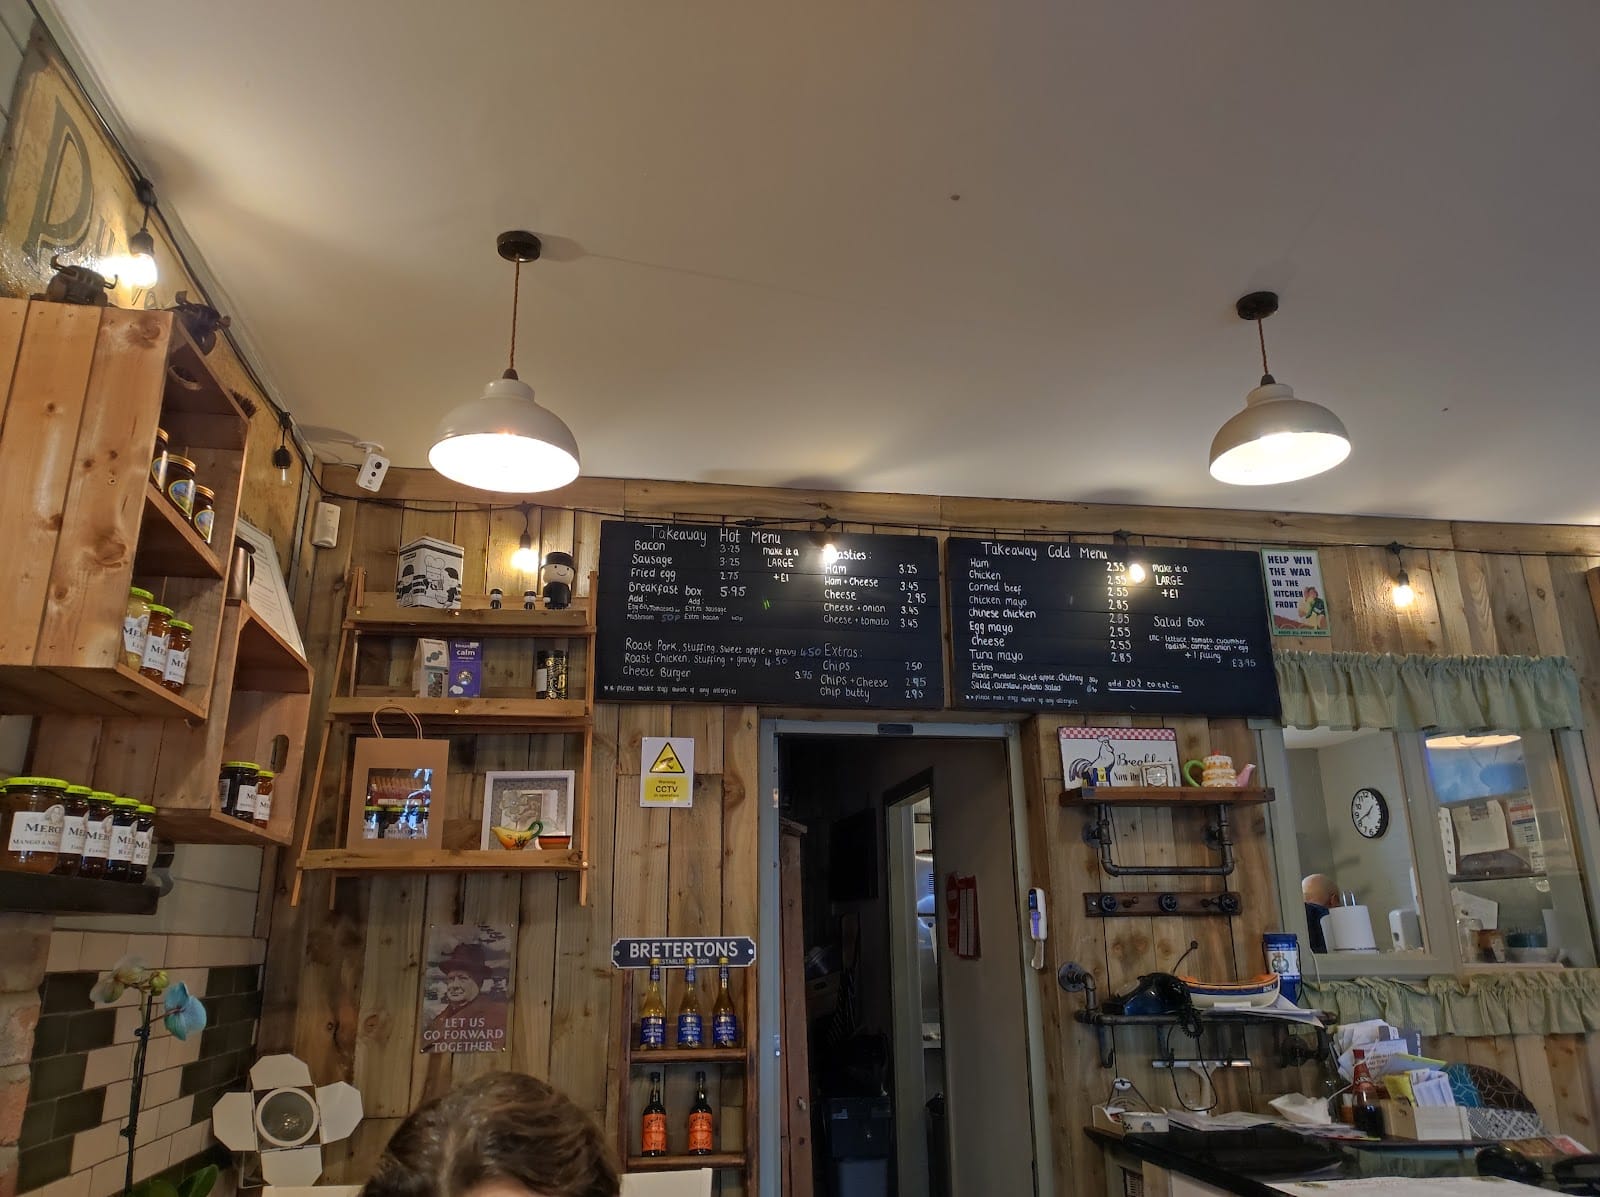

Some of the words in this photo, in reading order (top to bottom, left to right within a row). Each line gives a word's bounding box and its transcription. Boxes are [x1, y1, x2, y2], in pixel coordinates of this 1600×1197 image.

[644, 525, 707, 547] Takeaway
[720, 528, 741, 543] Hot
[751, 531, 781, 544] Menu
[634, 540, 665, 551] Bacon
[981, 541, 1037, 561] Takeaway
[1048, 544, 1071, 559] Cold
[1080, 547, 1108, 560] Menu
[632, 554, 672, 567] Sausage
[767, 558, 794, 568] LARGE
[970, 558, 989, 568] Ham
[1107, 562, 1126, 572] 2.55
[1267, 555, 1289, 564] HELP
[1294, 556, 1313, 565] WIN
[631, 568, 655, 578] Fried
[660, 570, 676, 582] egg
[720, 571, 739, 580] 2.75
[825, 564, 847, 575] Ham
[899, 564, 918, 574] 3.25
[1152, 564, 1172, 573] make
[1269, 567, 1286, 576] THE
[1290, 568, 1312, 577] WAR
[824, 577, 842, 586] Ham
[849, 578, 879, 587] Cheese
[900, 582, 919, 591] 3.45
[969, 570, 1001, 580] Chicken
[1107, 575, 1127, 585] 2.55
[1156, 575, 1184, 586] LARGE
[1272, 579, 1282, 587] ON
[629, 582, 678, 595] Breakfast
[685, 585, 702, 596] box
[720, 586, 747, 597] 5.95
[969, 582, 1000, 592] Corned
[1004, 582, 1022, 595] beef
[1107, 587, 1129, 597] 2.55
[1274, 590, 1304, 598] KITCHEN
[824, 590, 857, 600] Cheese
[907, 593, 927, 604] 2.95
[969, 595, 1000, 605] Chicken
[1005, 598, 1027, 610] mayo
[1108, 599, 1129, 610] 2.85
[824, 603, 854, 612] Cheese
[863, 604, 886, 612] onion
[901, 607, 919, 615] 3.45
[1275, 601, 1299, 609] FRONT
[968, 609, 999, 618] Chinese
[823, 615, 852, 624] Cheese
[861, 616, 890, 626] tomato
[901, 618, 918, 628] 3.45
[1154, 616, 1181, 627] Salad
[1187, 617, 1206, 627] Box
[969, 621, 985, 634] Egg
[988, 623, 1013, 635] mayo
[1109, 627, 1131, 638] 2.55
[625, 637, 652, 651] Roast
[720, 645, 742, 654] sweet
[746, 646, 765, 656] apple
[774, 648, 797, 661] gravy
[971, 636, 1005, 647] Cheese
[1110, 640, 1131, 650] 2.55
[624, 652, 650, 664] Roast
[694, 654, 726, 667] stuffing
[736, 657, 757, 667] gravy
[969, 649, 993, 661] Tuna
[997, 651, 1024, 663] mayo
[1111, 652, 1132, 663] 2.85
[1200, 652, 1222, 664] filling
[622, 665, 654, 677] Cheese
[660, 667, 691, 681] Burger
[822, 660, 850, 673] Chips
[972, 663, 993, 671] Extras
[820, 675, 847, 688] Chips
[856, 677, 889, 688] Cheese
[905, 678, 927, 687] 2.95
[820, 686, 841, 698] Chip
[845, 687, 870, 702] butty
[905, 689, 924, 699] 2.95
[655, 785, 678, 793] CCTV
[629, 941, 738, 958] BRETERTONS
[445, 1018, 465, 1028] LET
[469, 1018, 485, 1027] US
[423, 1030, 440, 1040] GO
[444, 1029, 504, 1040] FORWARD
[432, 1042, 494, 1052] TOGETHER
